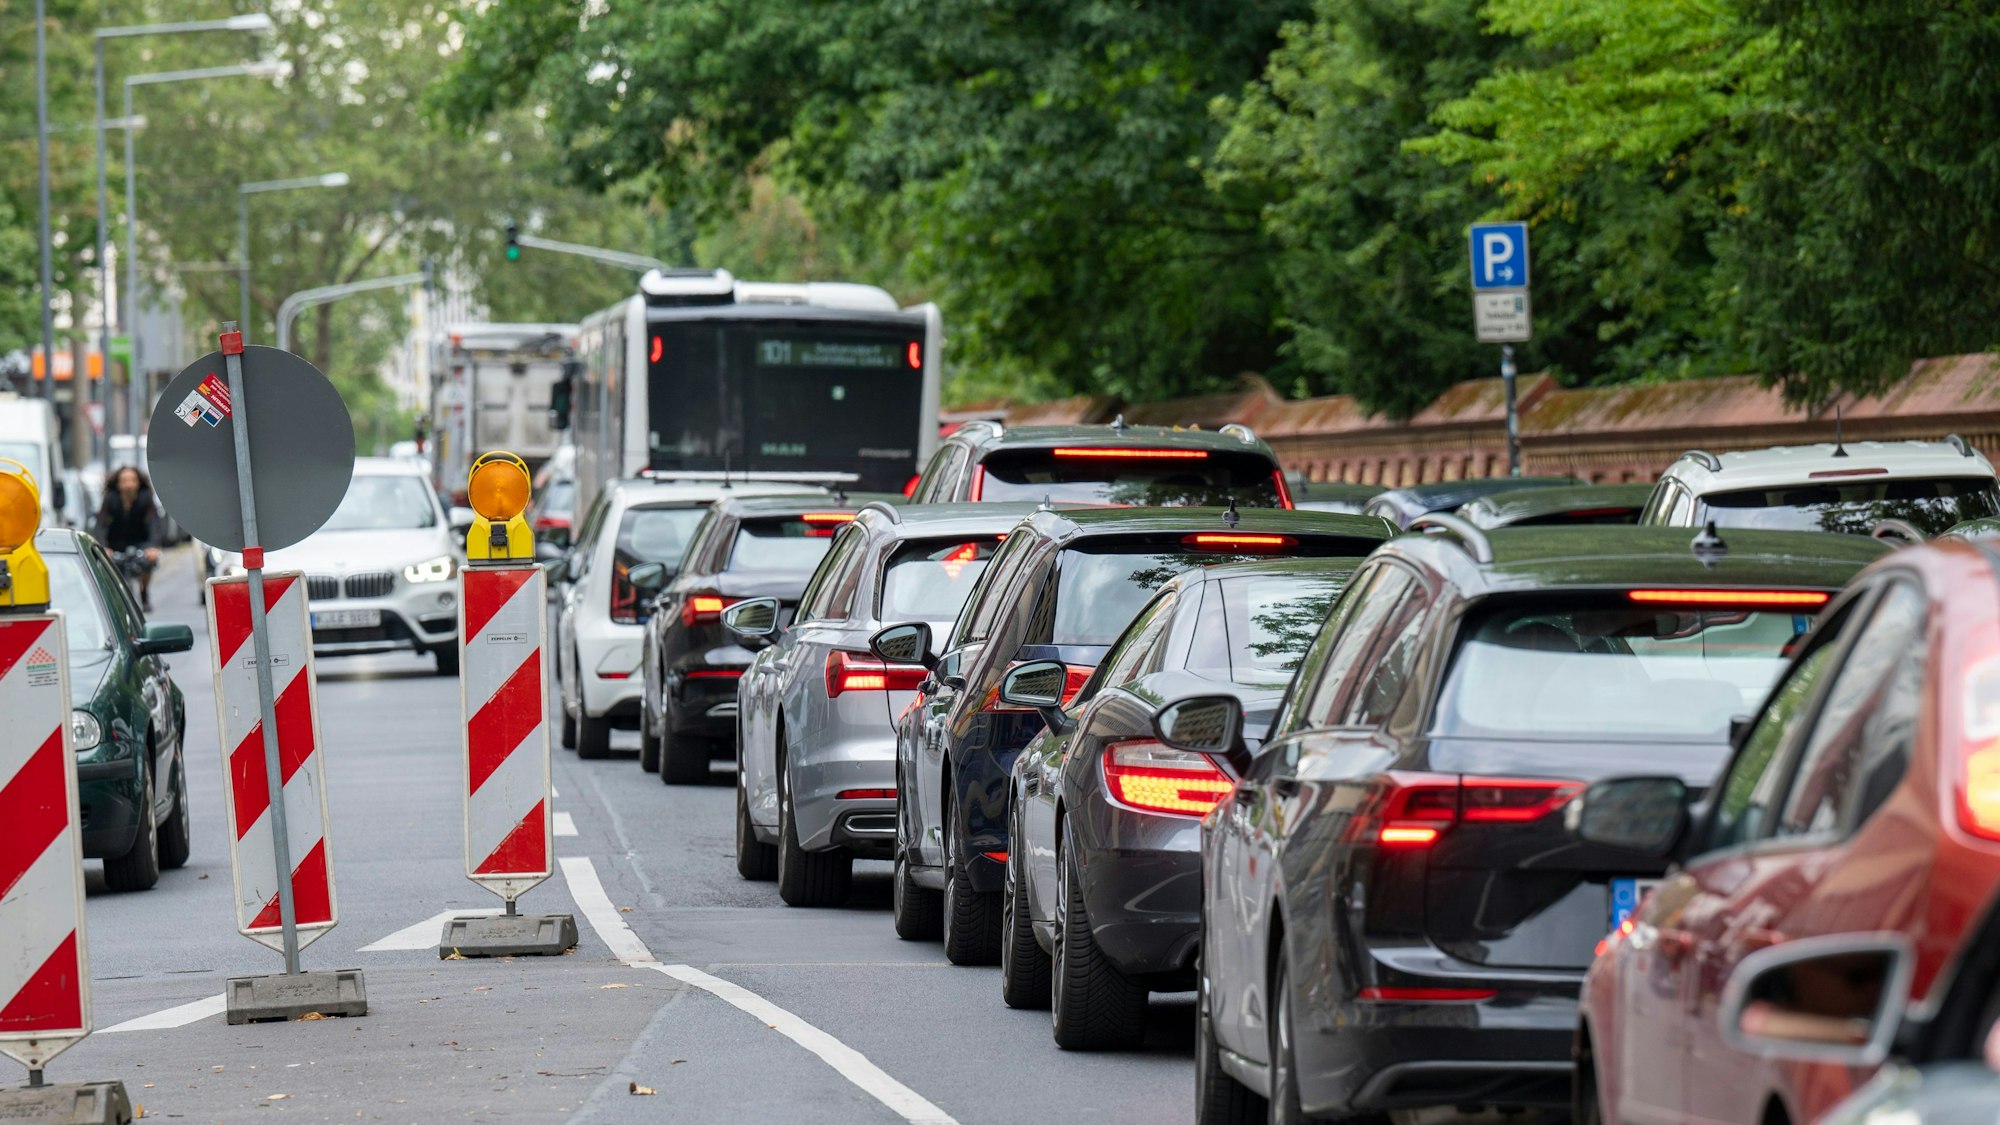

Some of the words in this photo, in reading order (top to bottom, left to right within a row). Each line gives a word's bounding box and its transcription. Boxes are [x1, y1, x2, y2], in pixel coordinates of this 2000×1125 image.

[1483, 232, 1514, 282] P
[762, 340, 791, 364] 101
[210, 394, 231, 414] ZEPPELIN
